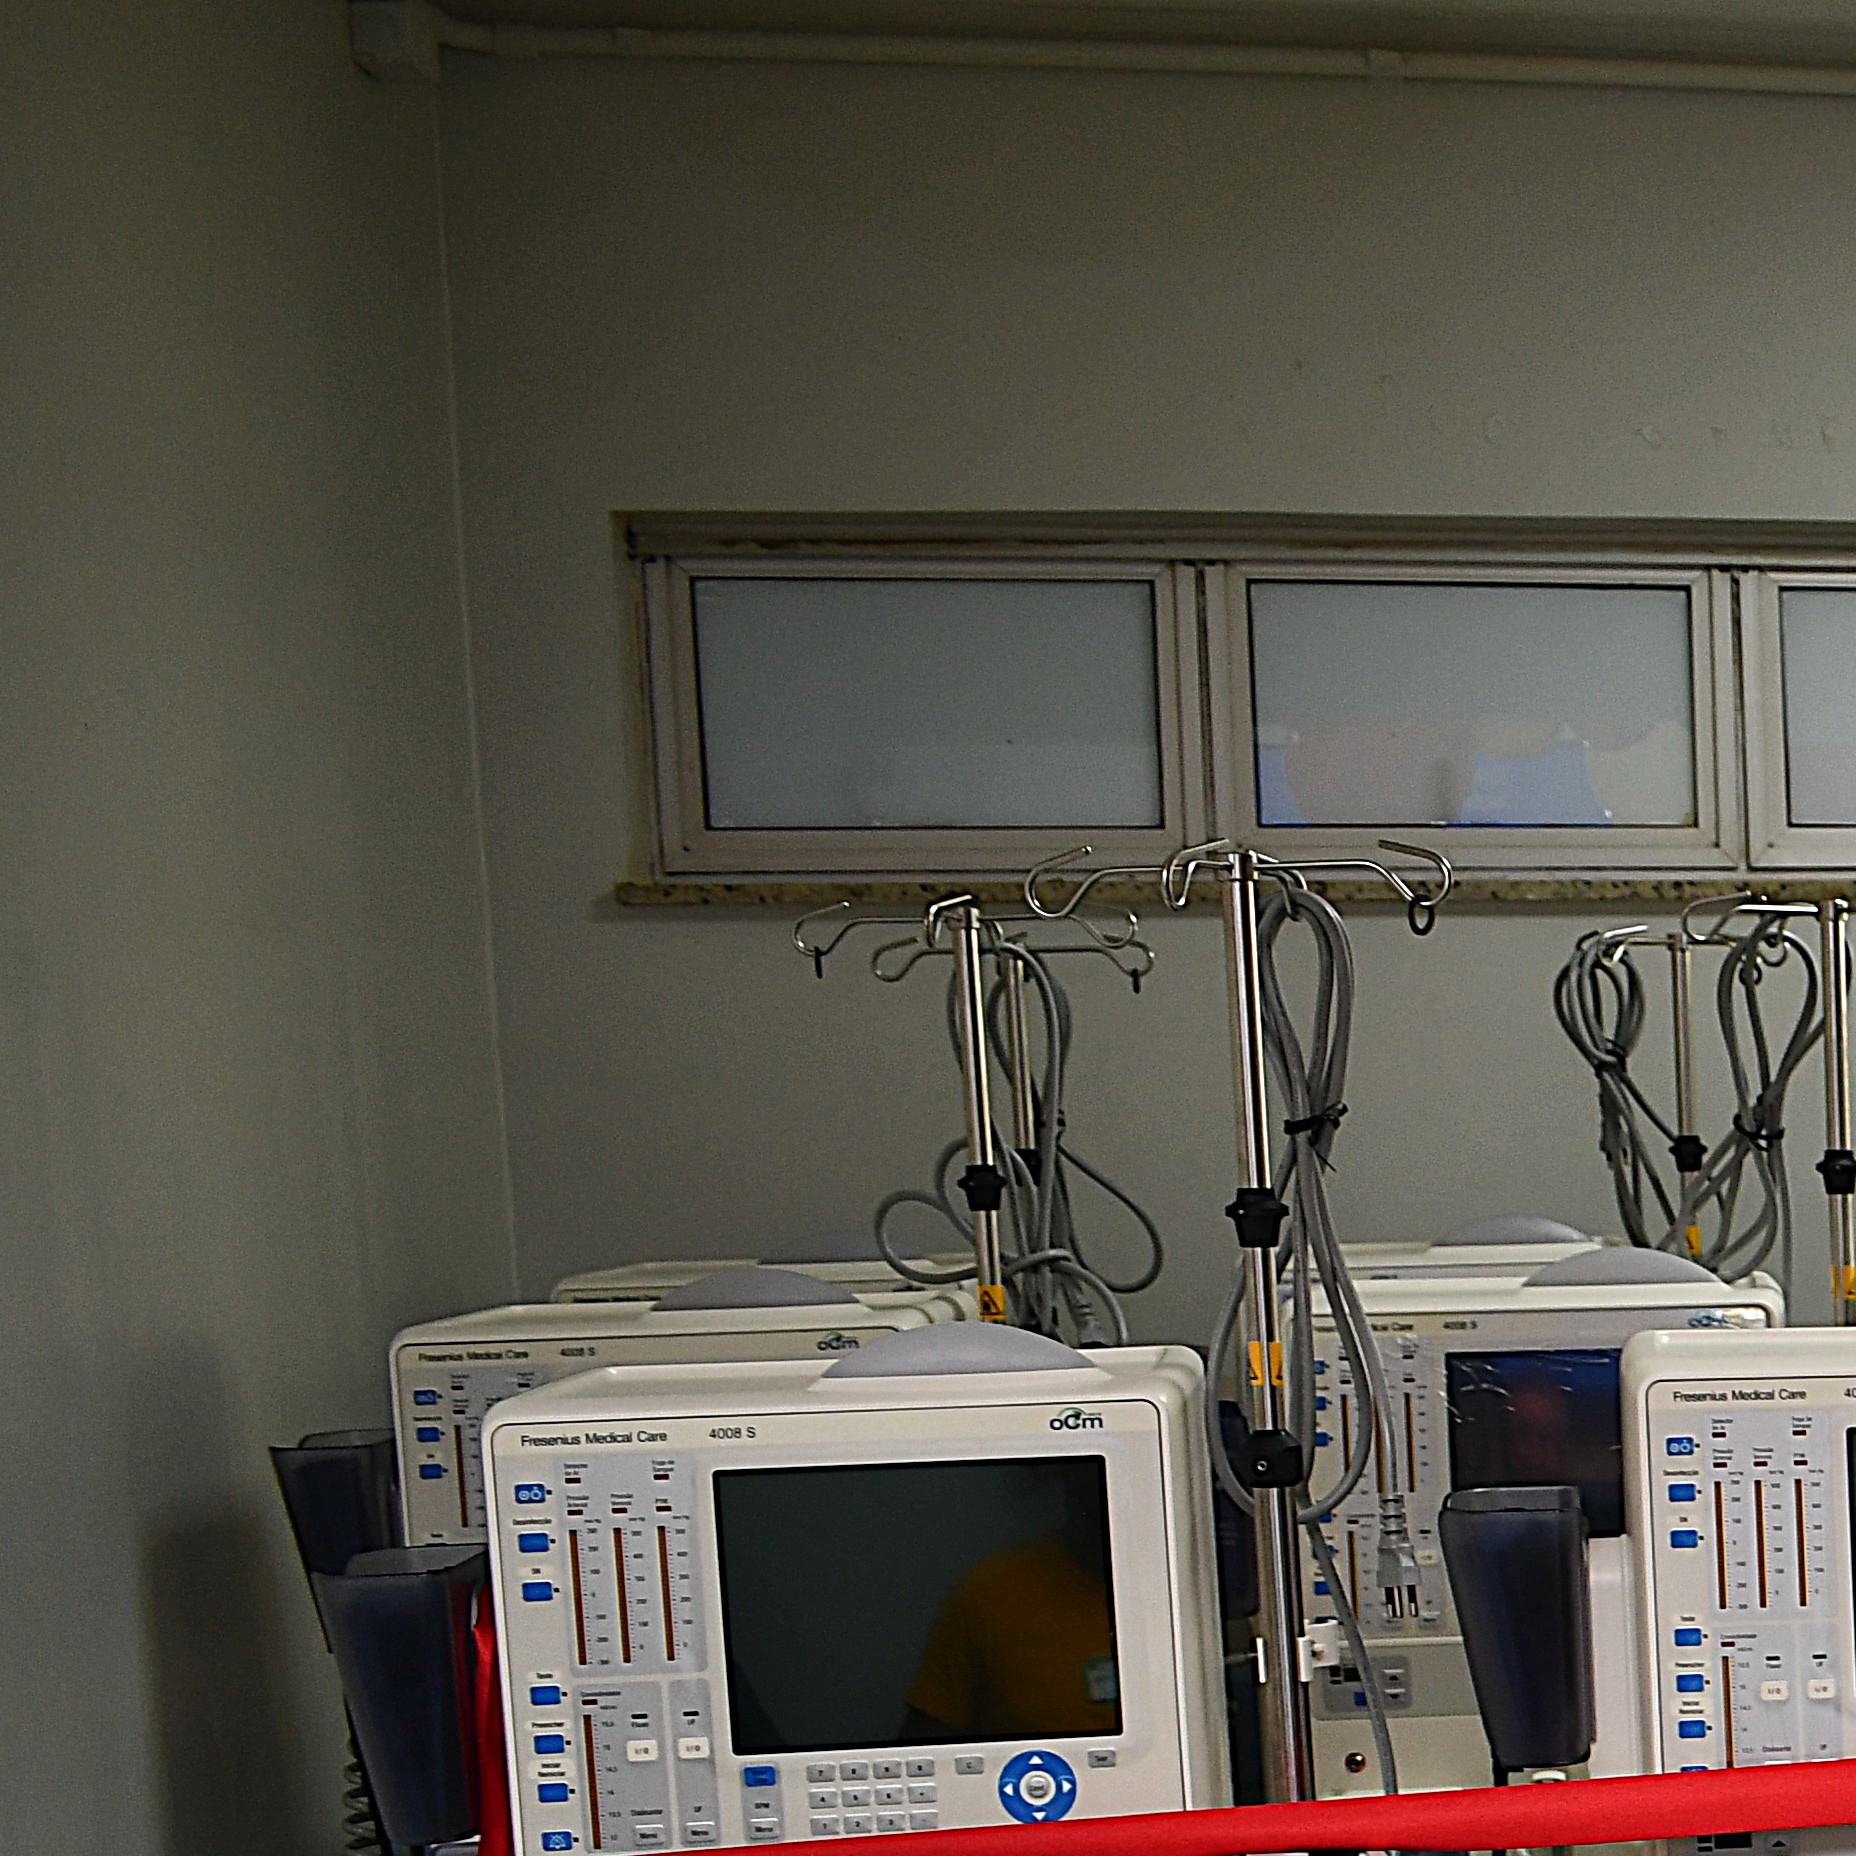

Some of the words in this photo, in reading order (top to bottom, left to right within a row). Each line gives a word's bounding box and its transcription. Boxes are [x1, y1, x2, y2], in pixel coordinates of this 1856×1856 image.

[1673, 1391, 1728, 1402] Fresenius
[1732, 1390, 1775, 1400] Medical
[1778, 1389, 1807, 1400] Care
[1049, 1413, 1103, 1431] oCm
[521, 1435, 581, 1446] Fresenius
[585, 1432, 633, 1444] Medical
[637, 1431, 667, 1442] Care
[709, 1428, 742, 1439] 4008
[746, 1427, 756, 1438] S
